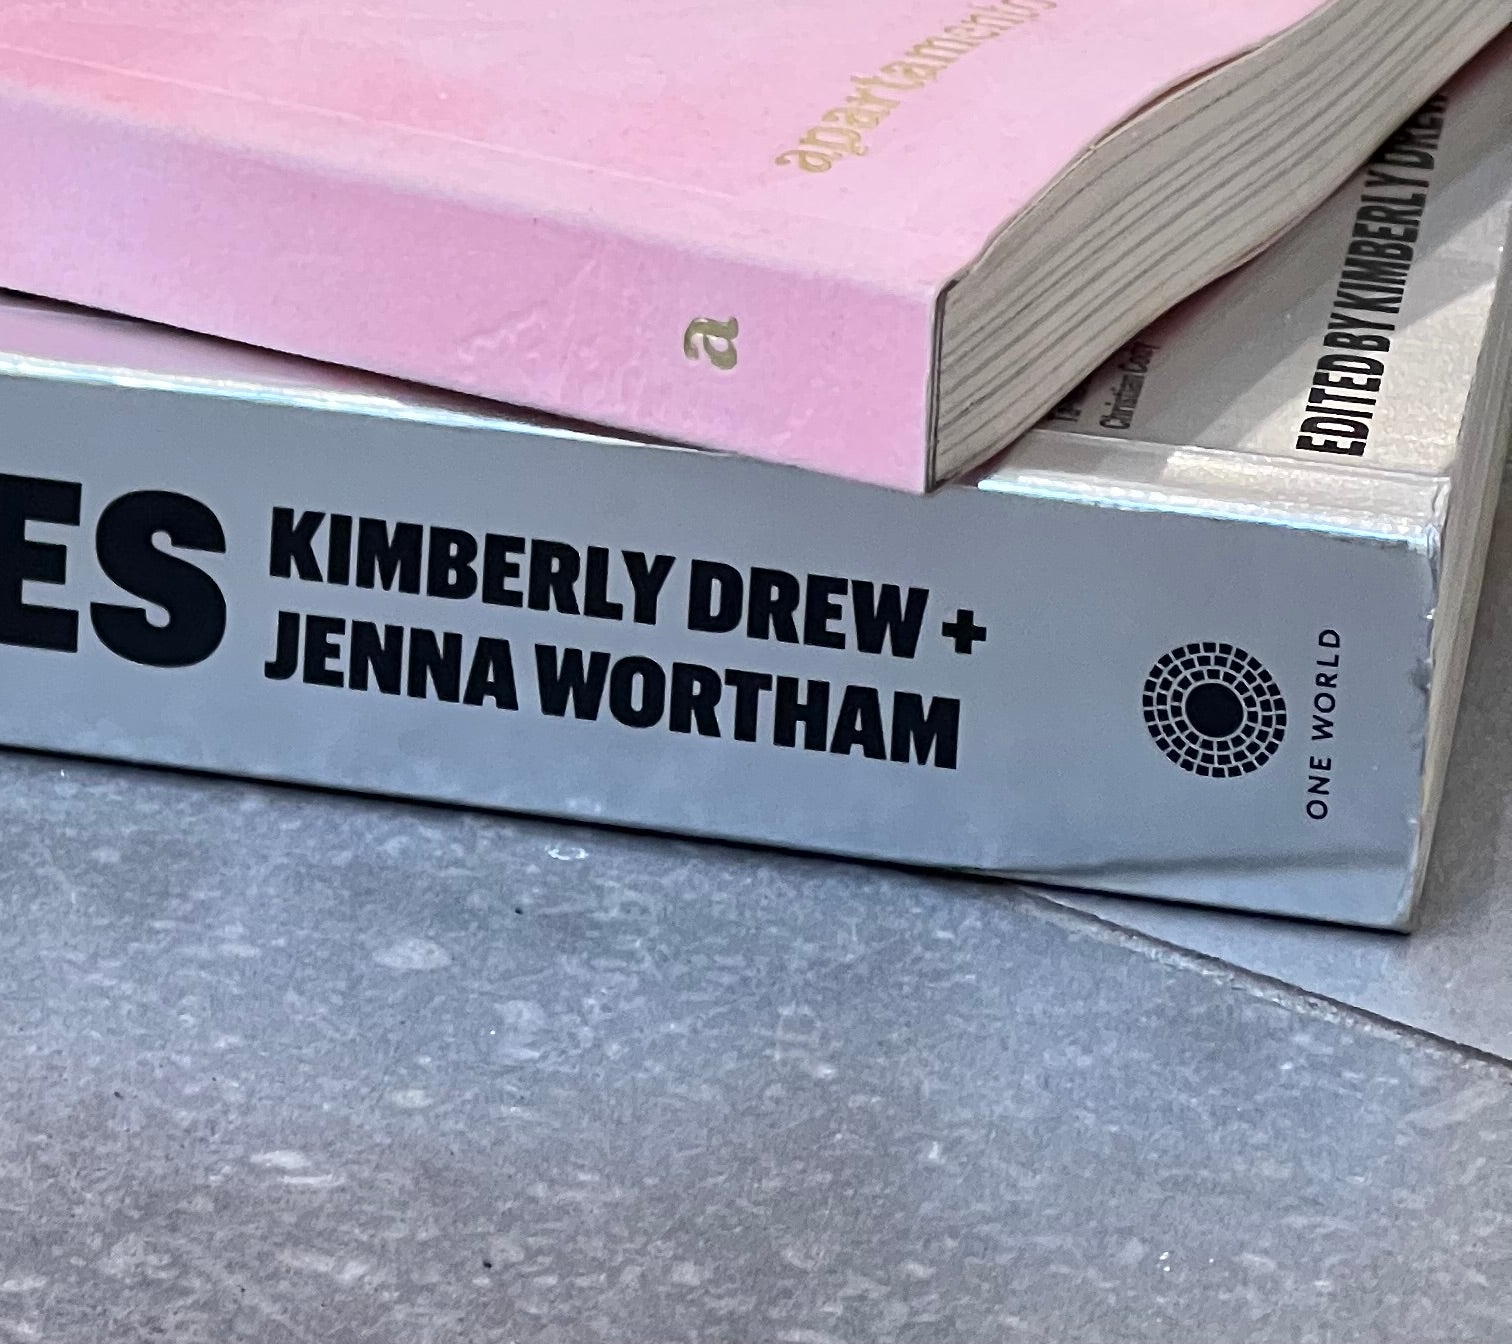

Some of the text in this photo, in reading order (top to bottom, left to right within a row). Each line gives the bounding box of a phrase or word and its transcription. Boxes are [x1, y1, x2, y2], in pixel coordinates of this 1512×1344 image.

[1333, 169, 1431, 313] KIMBERLY
[684, 316, 739, 370] a
[1323, 312, 1395, 352] BY
[1296, 354, 1384, 456] EDITED
[270, 507, 986, 658] KIMBERLY DREW +
[265, 611, 960, 769] JENNA WORTHAM
[1305, 628, 1341, 820] ONE WORLD
